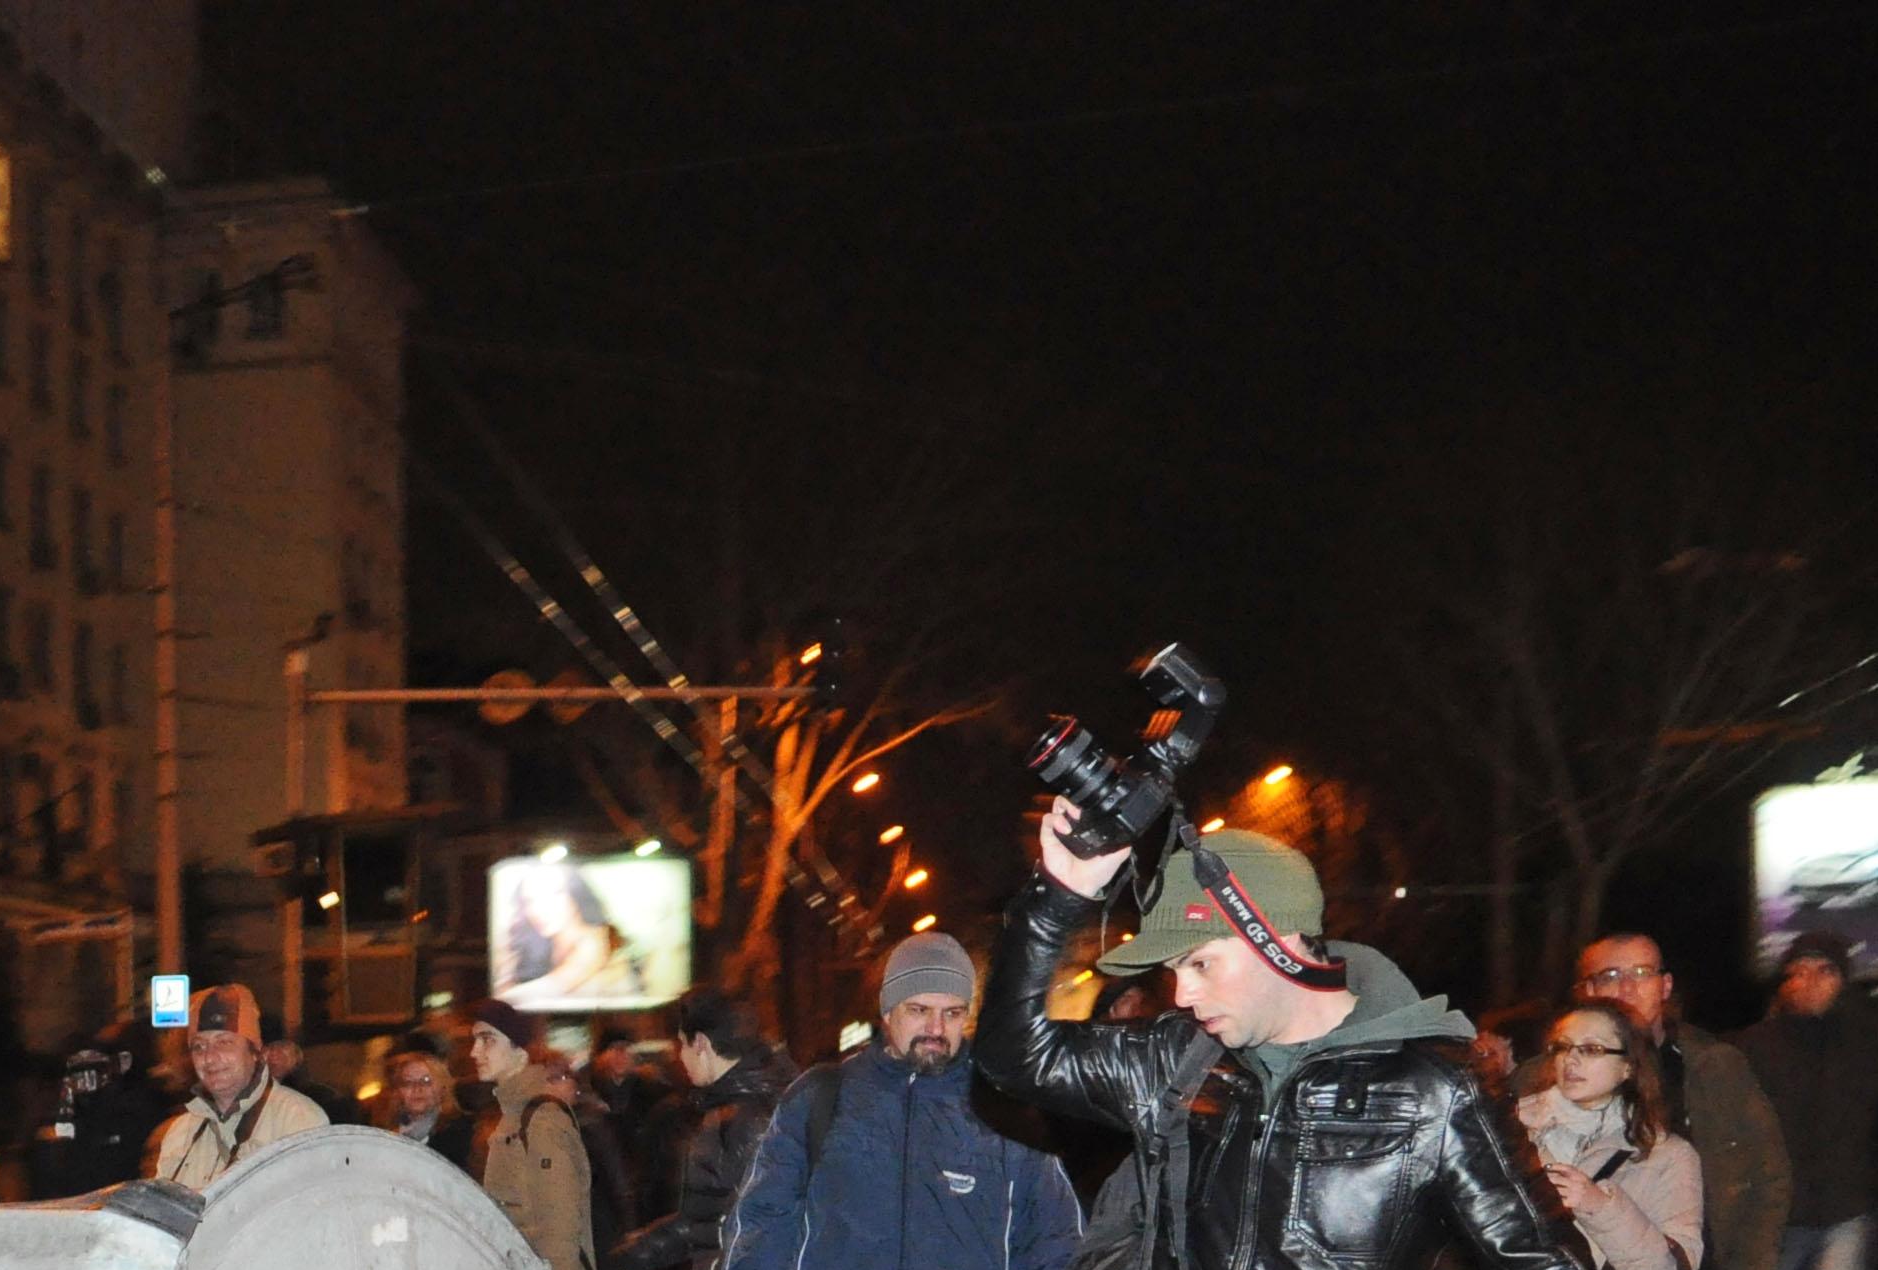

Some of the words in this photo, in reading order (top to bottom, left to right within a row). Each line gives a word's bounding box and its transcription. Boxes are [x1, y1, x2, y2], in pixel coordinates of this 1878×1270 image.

[1227, 894, 1253, 921] Mark
[1245, 922, 1270, 944] 5D
[1263, 943, 1303, 975] EOS
